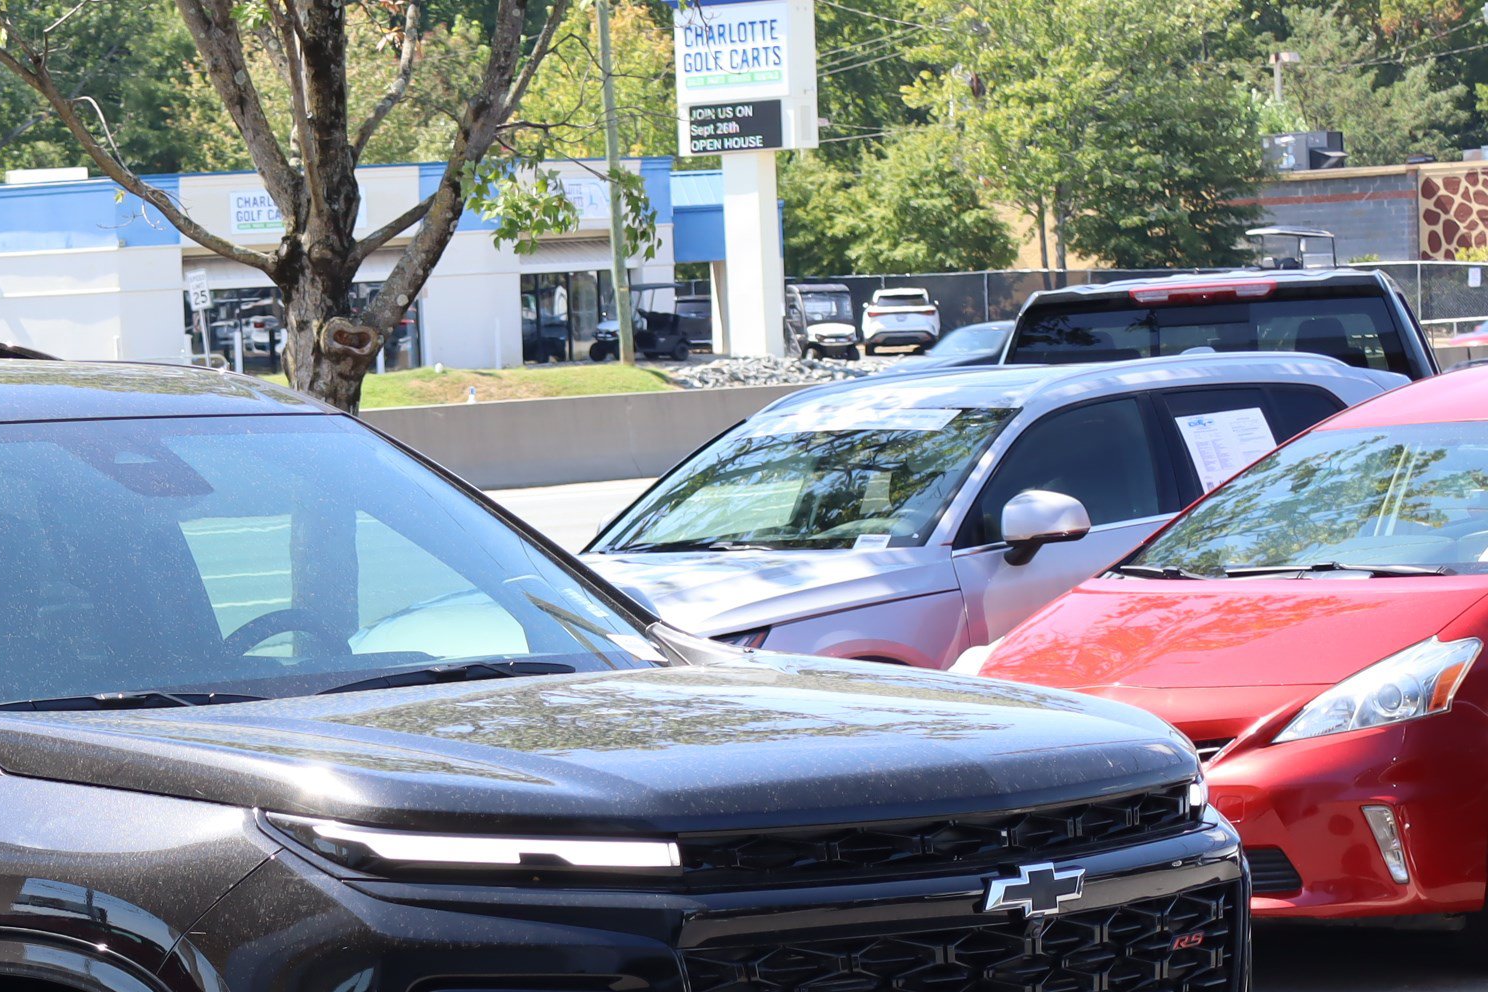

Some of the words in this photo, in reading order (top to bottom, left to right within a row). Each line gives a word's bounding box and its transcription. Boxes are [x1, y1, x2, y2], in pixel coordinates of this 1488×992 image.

[684, 19, 779, 47] CHARLOTTE
[683, 50, 723, 73] GOLF
[729, 45, 782, 69] CARTS
[692, 108, 716, 121] JOIN
[717, 107, 733, 119] US
[735, 105, 753, 117] ON
[690, 123, 715, 137] Sept
[691, 139, 722, 152] OPEN
[723, 135, 764, 149] HOUSE
[193, 290, 208, 306] 25
[1173, 931, 1204, 950] RS
